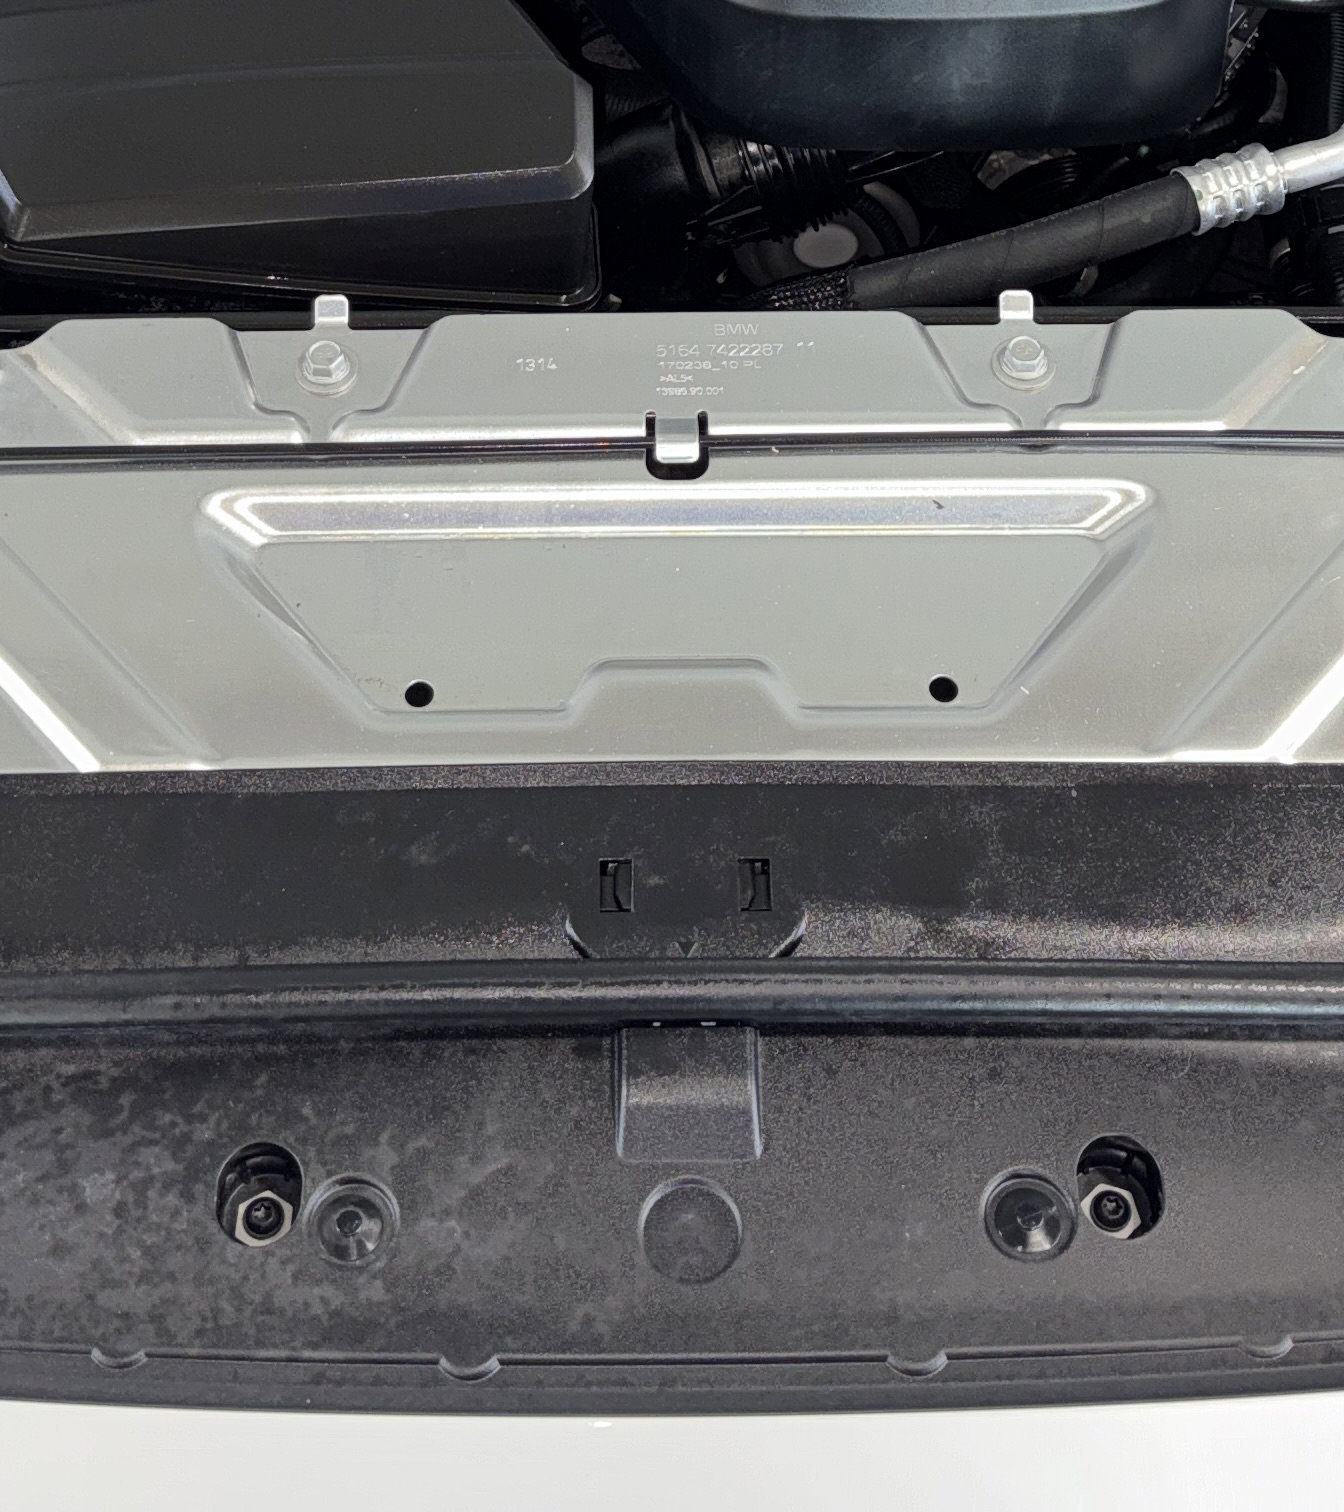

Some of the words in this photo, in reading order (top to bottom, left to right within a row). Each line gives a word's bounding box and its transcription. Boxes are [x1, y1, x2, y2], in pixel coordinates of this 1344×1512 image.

[714, 323, 760, 336] BMW
[656, 343, 701, 357] 5164
[707, 343, 783, 356] 7422287
[516, 358, 558, 372] 1314
